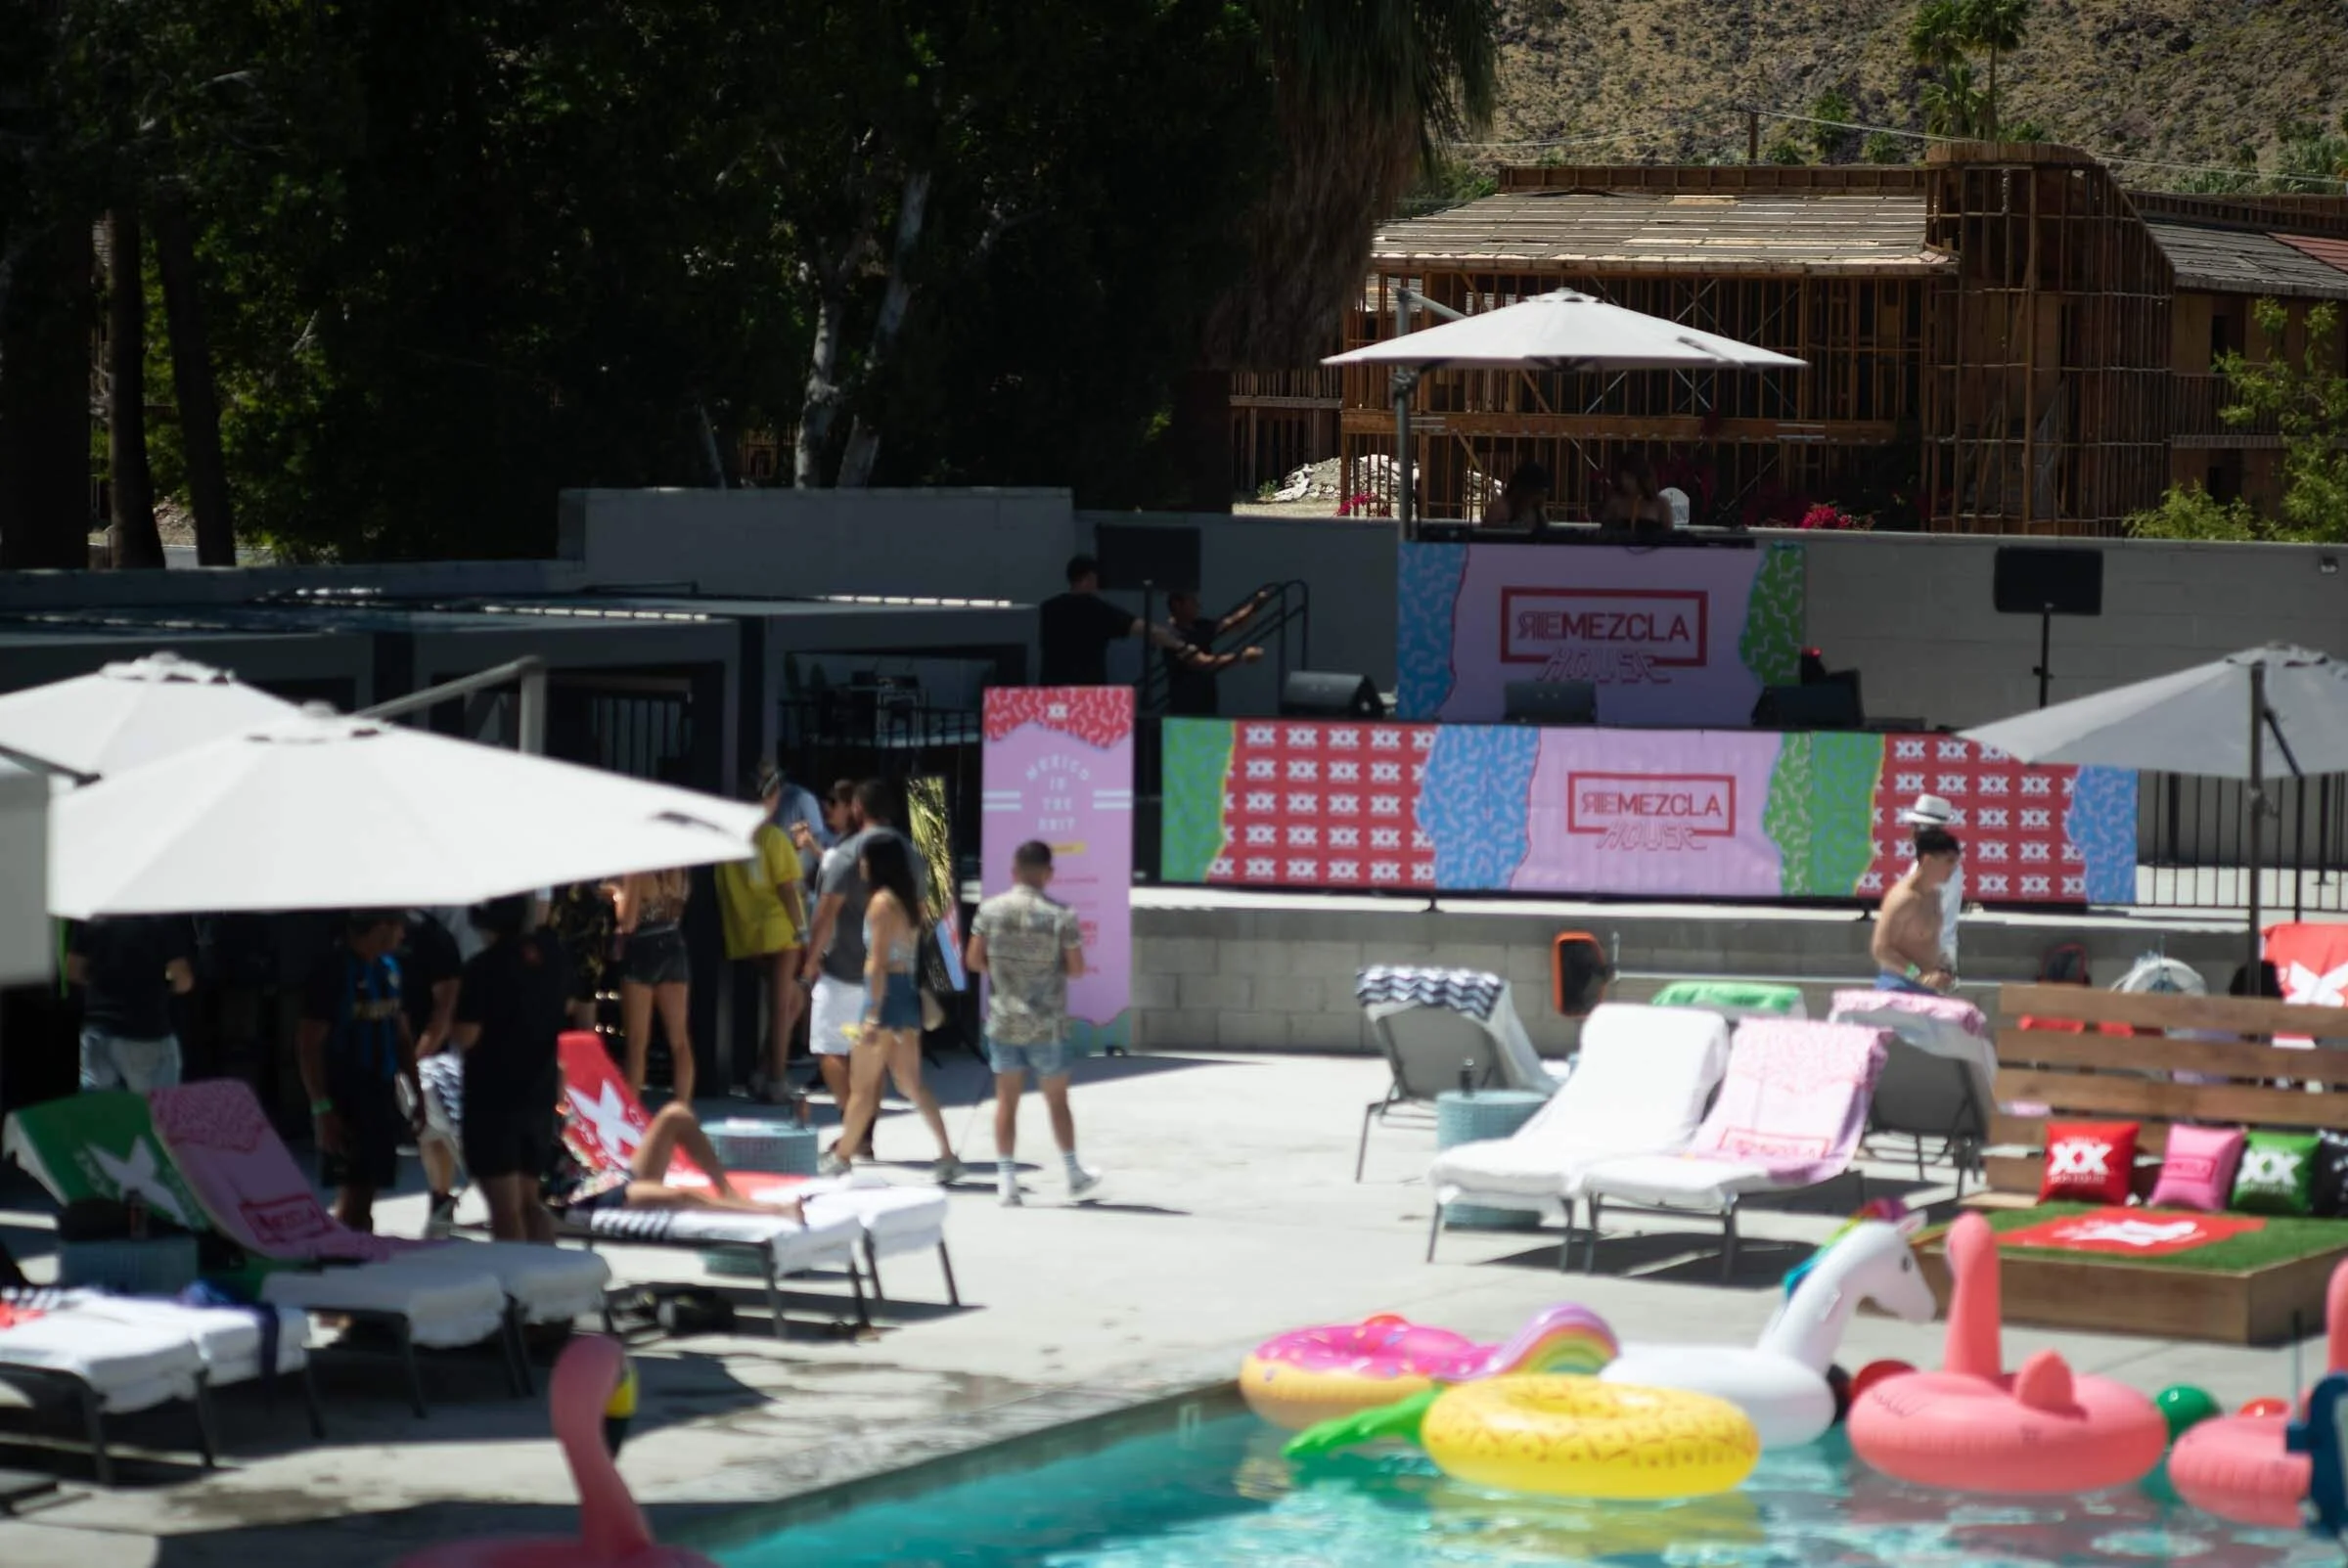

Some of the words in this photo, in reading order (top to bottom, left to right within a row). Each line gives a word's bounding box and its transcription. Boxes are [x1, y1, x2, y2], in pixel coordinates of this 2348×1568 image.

[1245, 726, 1276, 744] XX
[1287, 728, 1318, 746] XX
[1328, 729, 1359, 747] XX
[1370, 730, 1401, 748] XX
[1895, 740, 1925, 758] XX
[1937, 741, 1967, 759] XX
[1245, 759, 1276, 779] XX
[1287, 761, 1318, 780] XX
[1328, 762, 1359, 781] XX
[1370, 763, 1401, 782] XX
[1895, 774, 1925, 791] XX
[1937, 775, 1967, 792] XX
[1978, 776, 2009, 793] XX
[2020, 777, 2051, 794] XX
[1245, 792, 1276, 811] XX
[1287, 793, 1318, 812] XX
[1328, 795, 1359, 813] XX
[1370, 796, 1401, 815] XX
[1978, 808, 2009, 826] XX
[2020, 809, 2051, 827] XX
[1245, 826, 1276, 844] XX
[1287, 827, 1318, 845] XX
[1328, 829, 1359, 846] XX
[1370, 829, 1401, 847] XX
[1978, 841, 2009, 859] XX
[2020, 842, 2051, 860] XX
[1245, 858, 1276, 876] XX
[1287, 860, 1318, 877] XX
[1328, 861, 1359, 878] XX
[1370, 863, 1401, 880] XX
[1978, 874, 2009, 892] XX
[2020, 876, 2051, 894] XX
[2049, 1142, 2113, 1176] XX
[2236, 1148, 2303, 1185] XX
